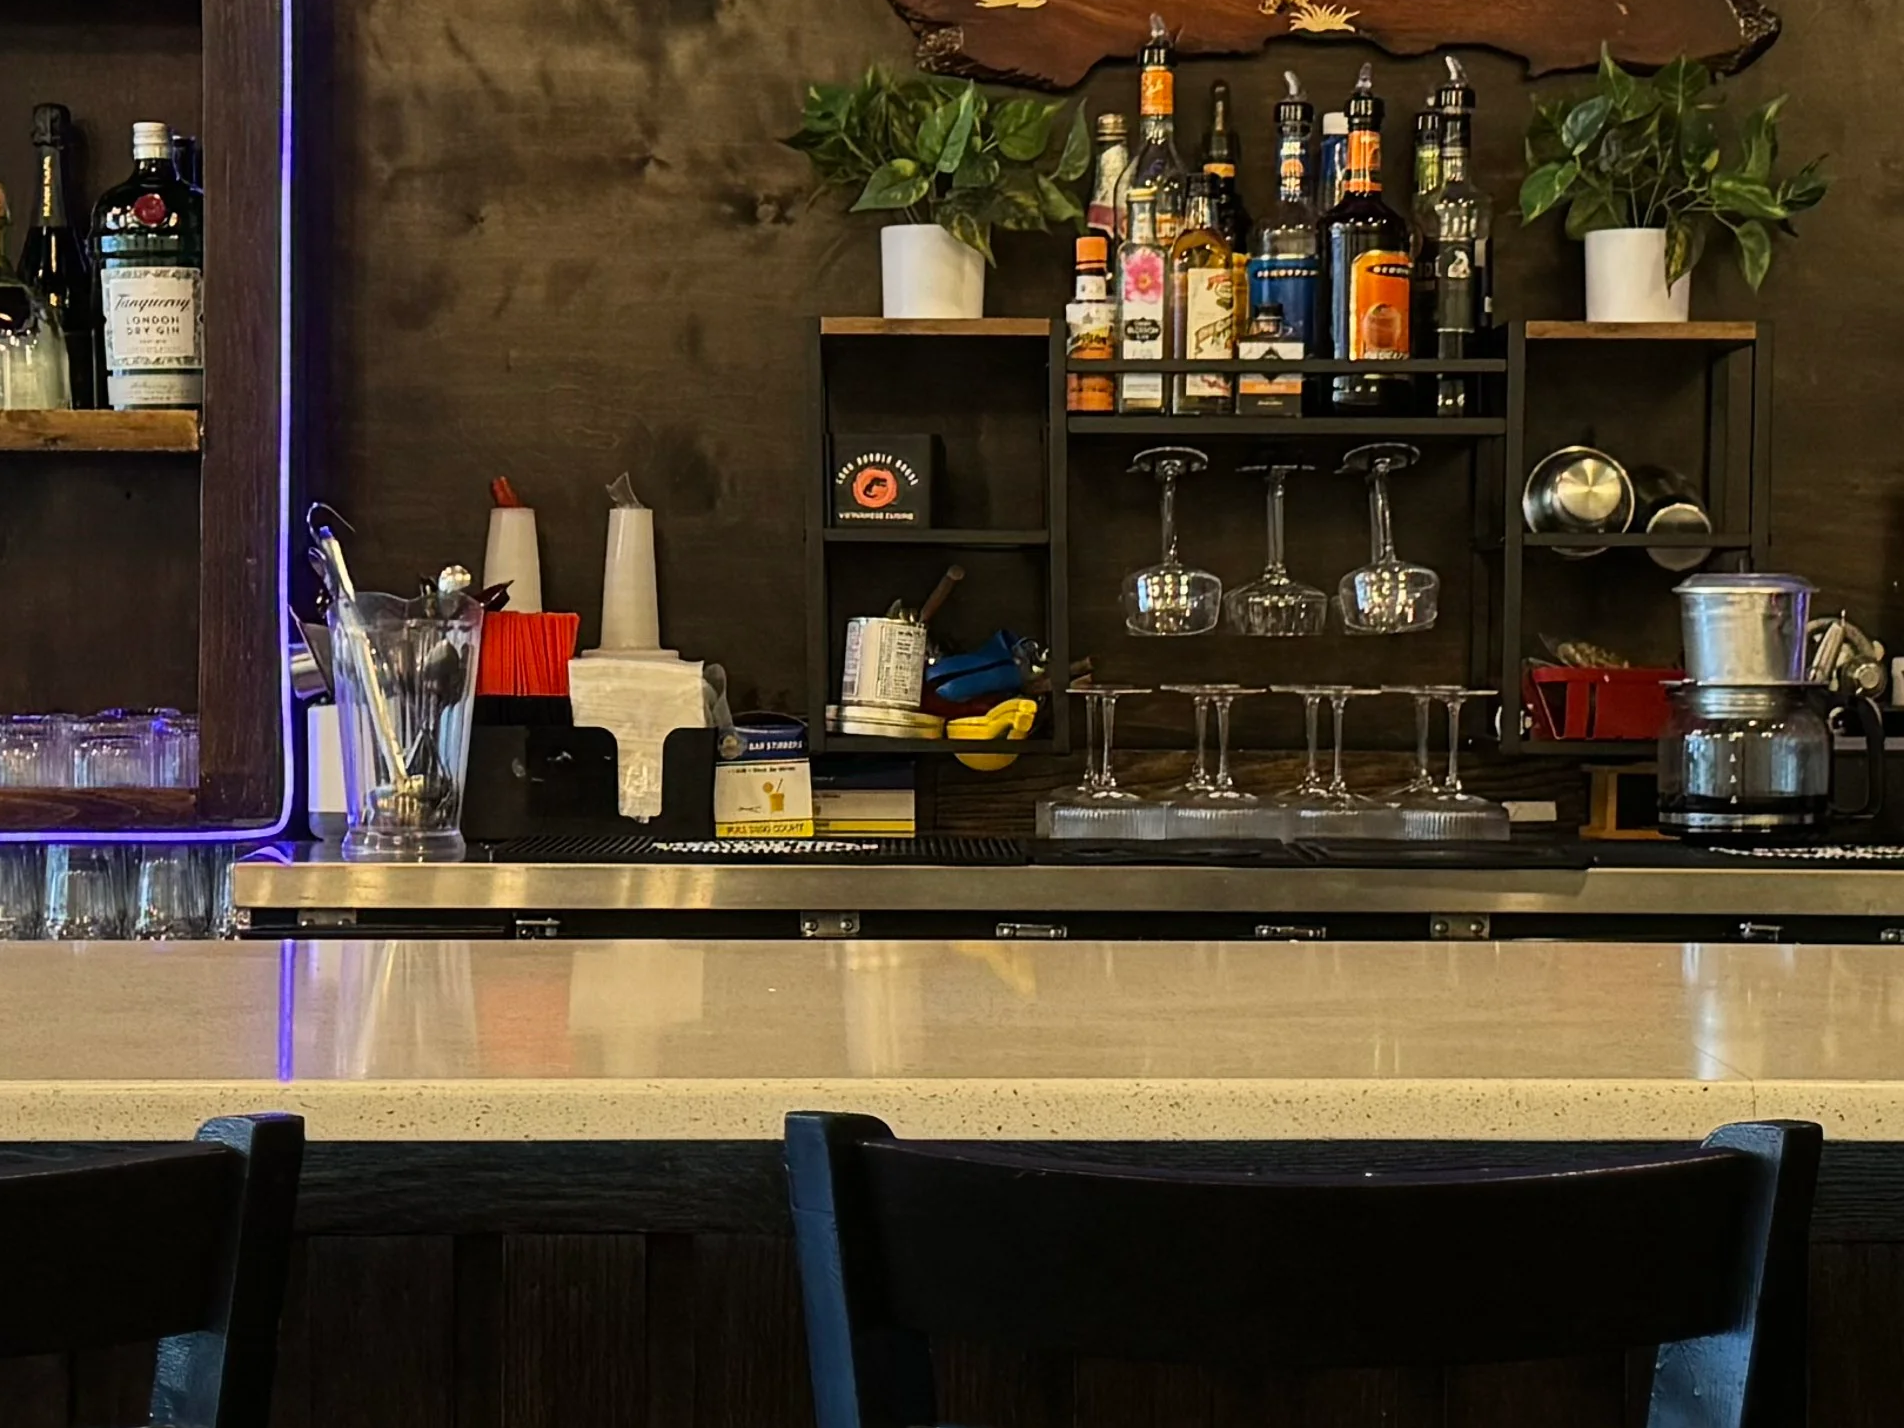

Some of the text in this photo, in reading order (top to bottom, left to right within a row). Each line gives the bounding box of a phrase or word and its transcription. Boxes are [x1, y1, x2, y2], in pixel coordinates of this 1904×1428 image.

[126, 315, 180, 325] LONDON
[126, 326, 180, 336] DRY GIN
